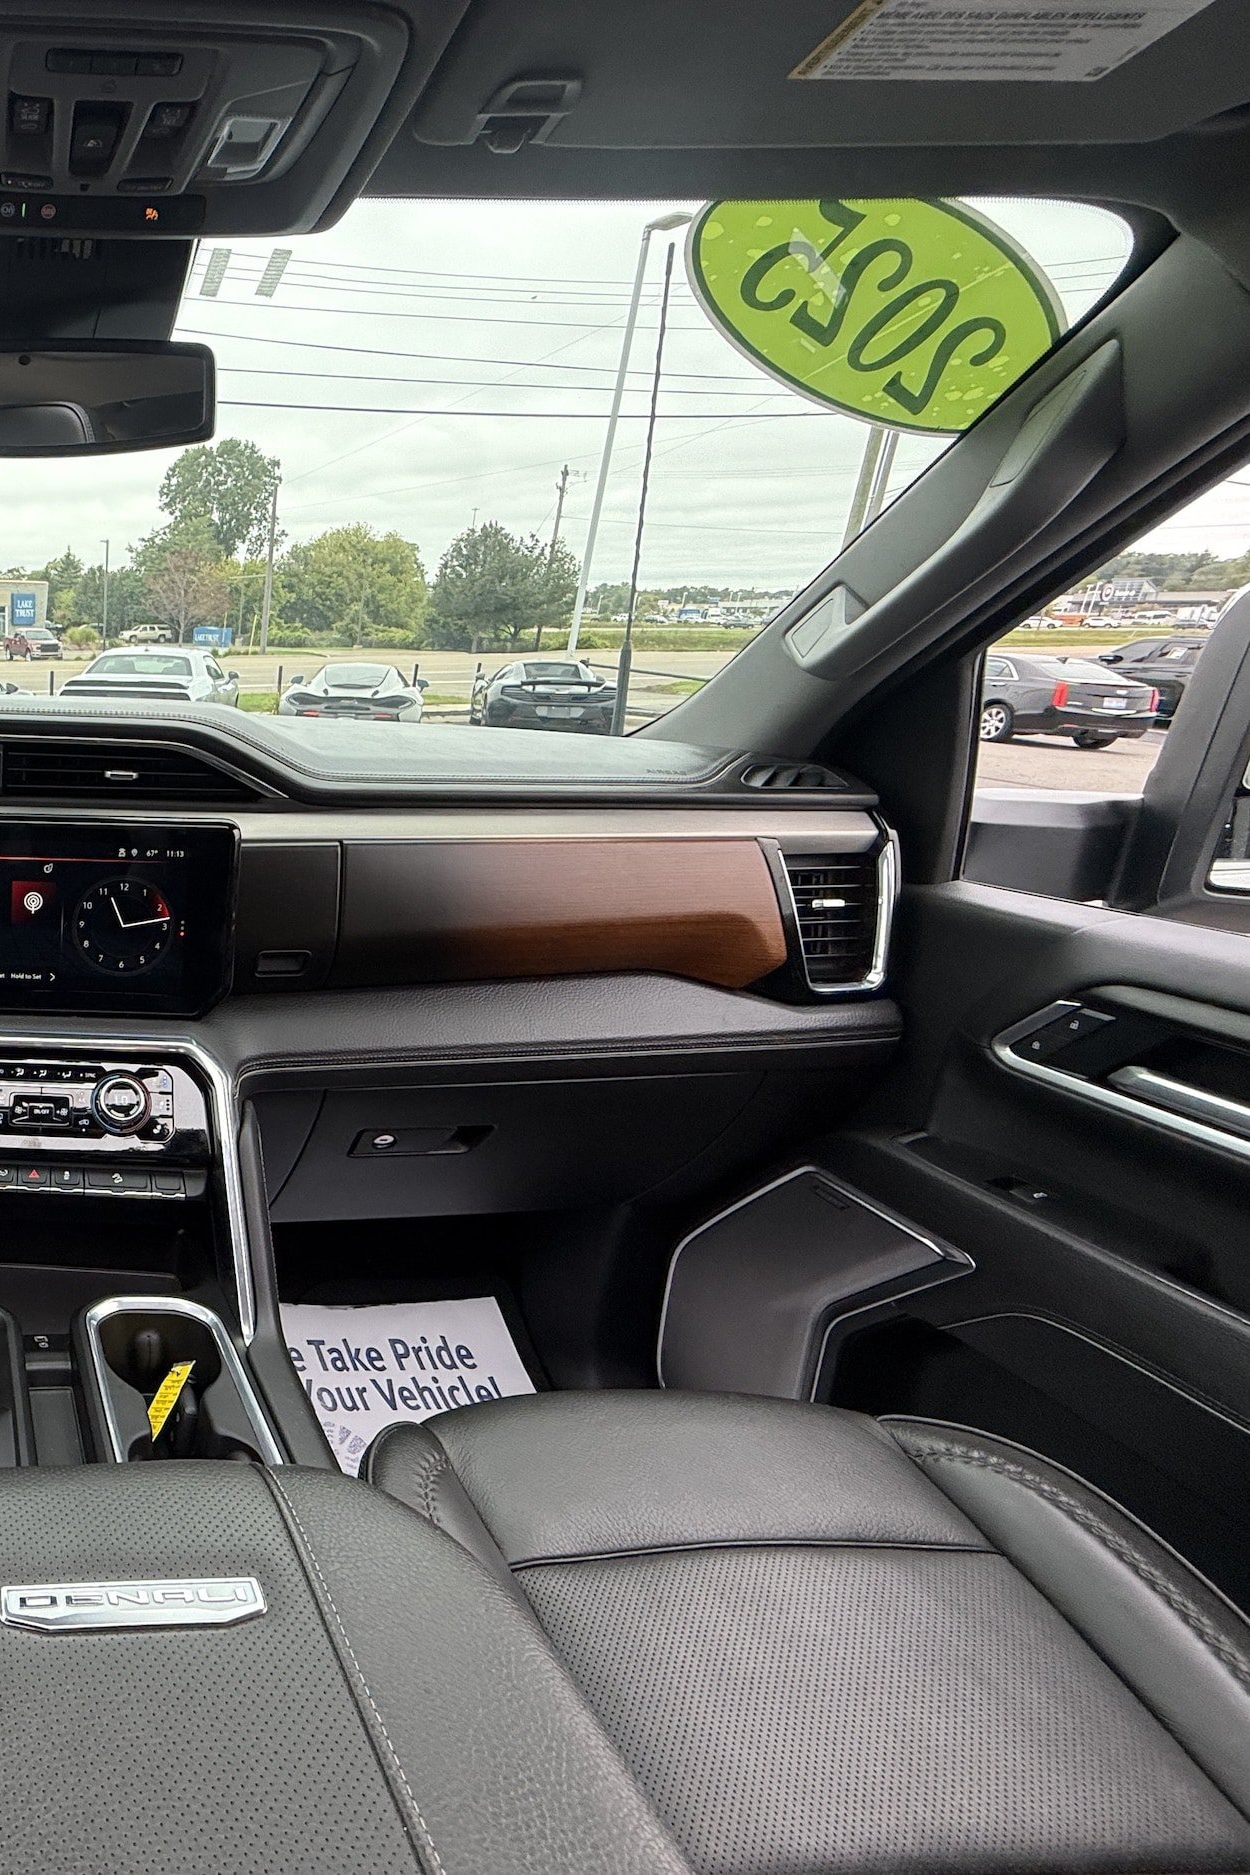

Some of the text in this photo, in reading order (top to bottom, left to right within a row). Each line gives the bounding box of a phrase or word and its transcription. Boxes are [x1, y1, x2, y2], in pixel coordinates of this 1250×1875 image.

[17, 600, 33, 608] LAKE
[15, 609, 34, 617] TRUST
[166, 850, 185, 858] 11:13
[120, 883, 130, 892] 12
[99, 888, 108, 896] 11
[83, 902, 93, 910] 10
[306, 1338, 388, 1373] Take
[388, 1335, 478, 1371] Pride
[19, 1587, 248, 1608] DENALI
